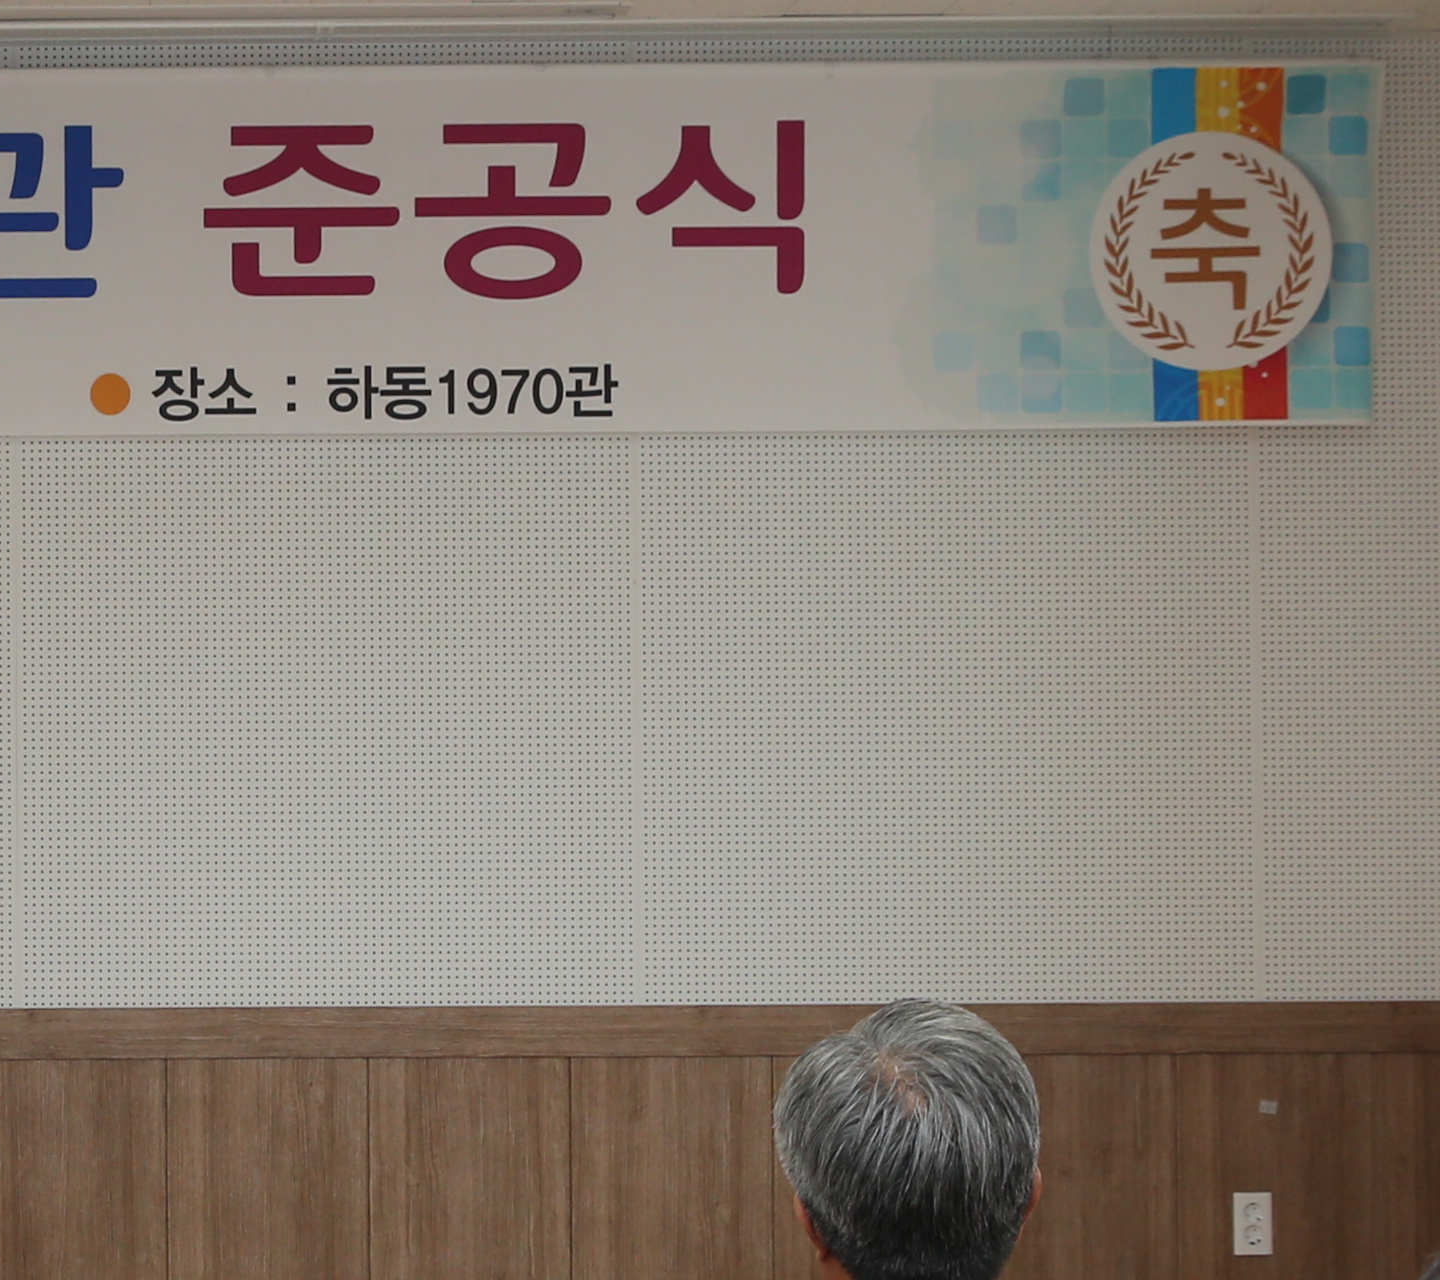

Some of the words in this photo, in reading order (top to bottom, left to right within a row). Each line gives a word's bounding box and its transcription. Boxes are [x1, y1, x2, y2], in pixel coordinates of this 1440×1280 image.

[203, 119, 806, 300] 준공식
[1148, 187, 1262, 312] 축
[151, 366, 257, 421] 장소
[325, 363, 619, 421] 하동1970관
